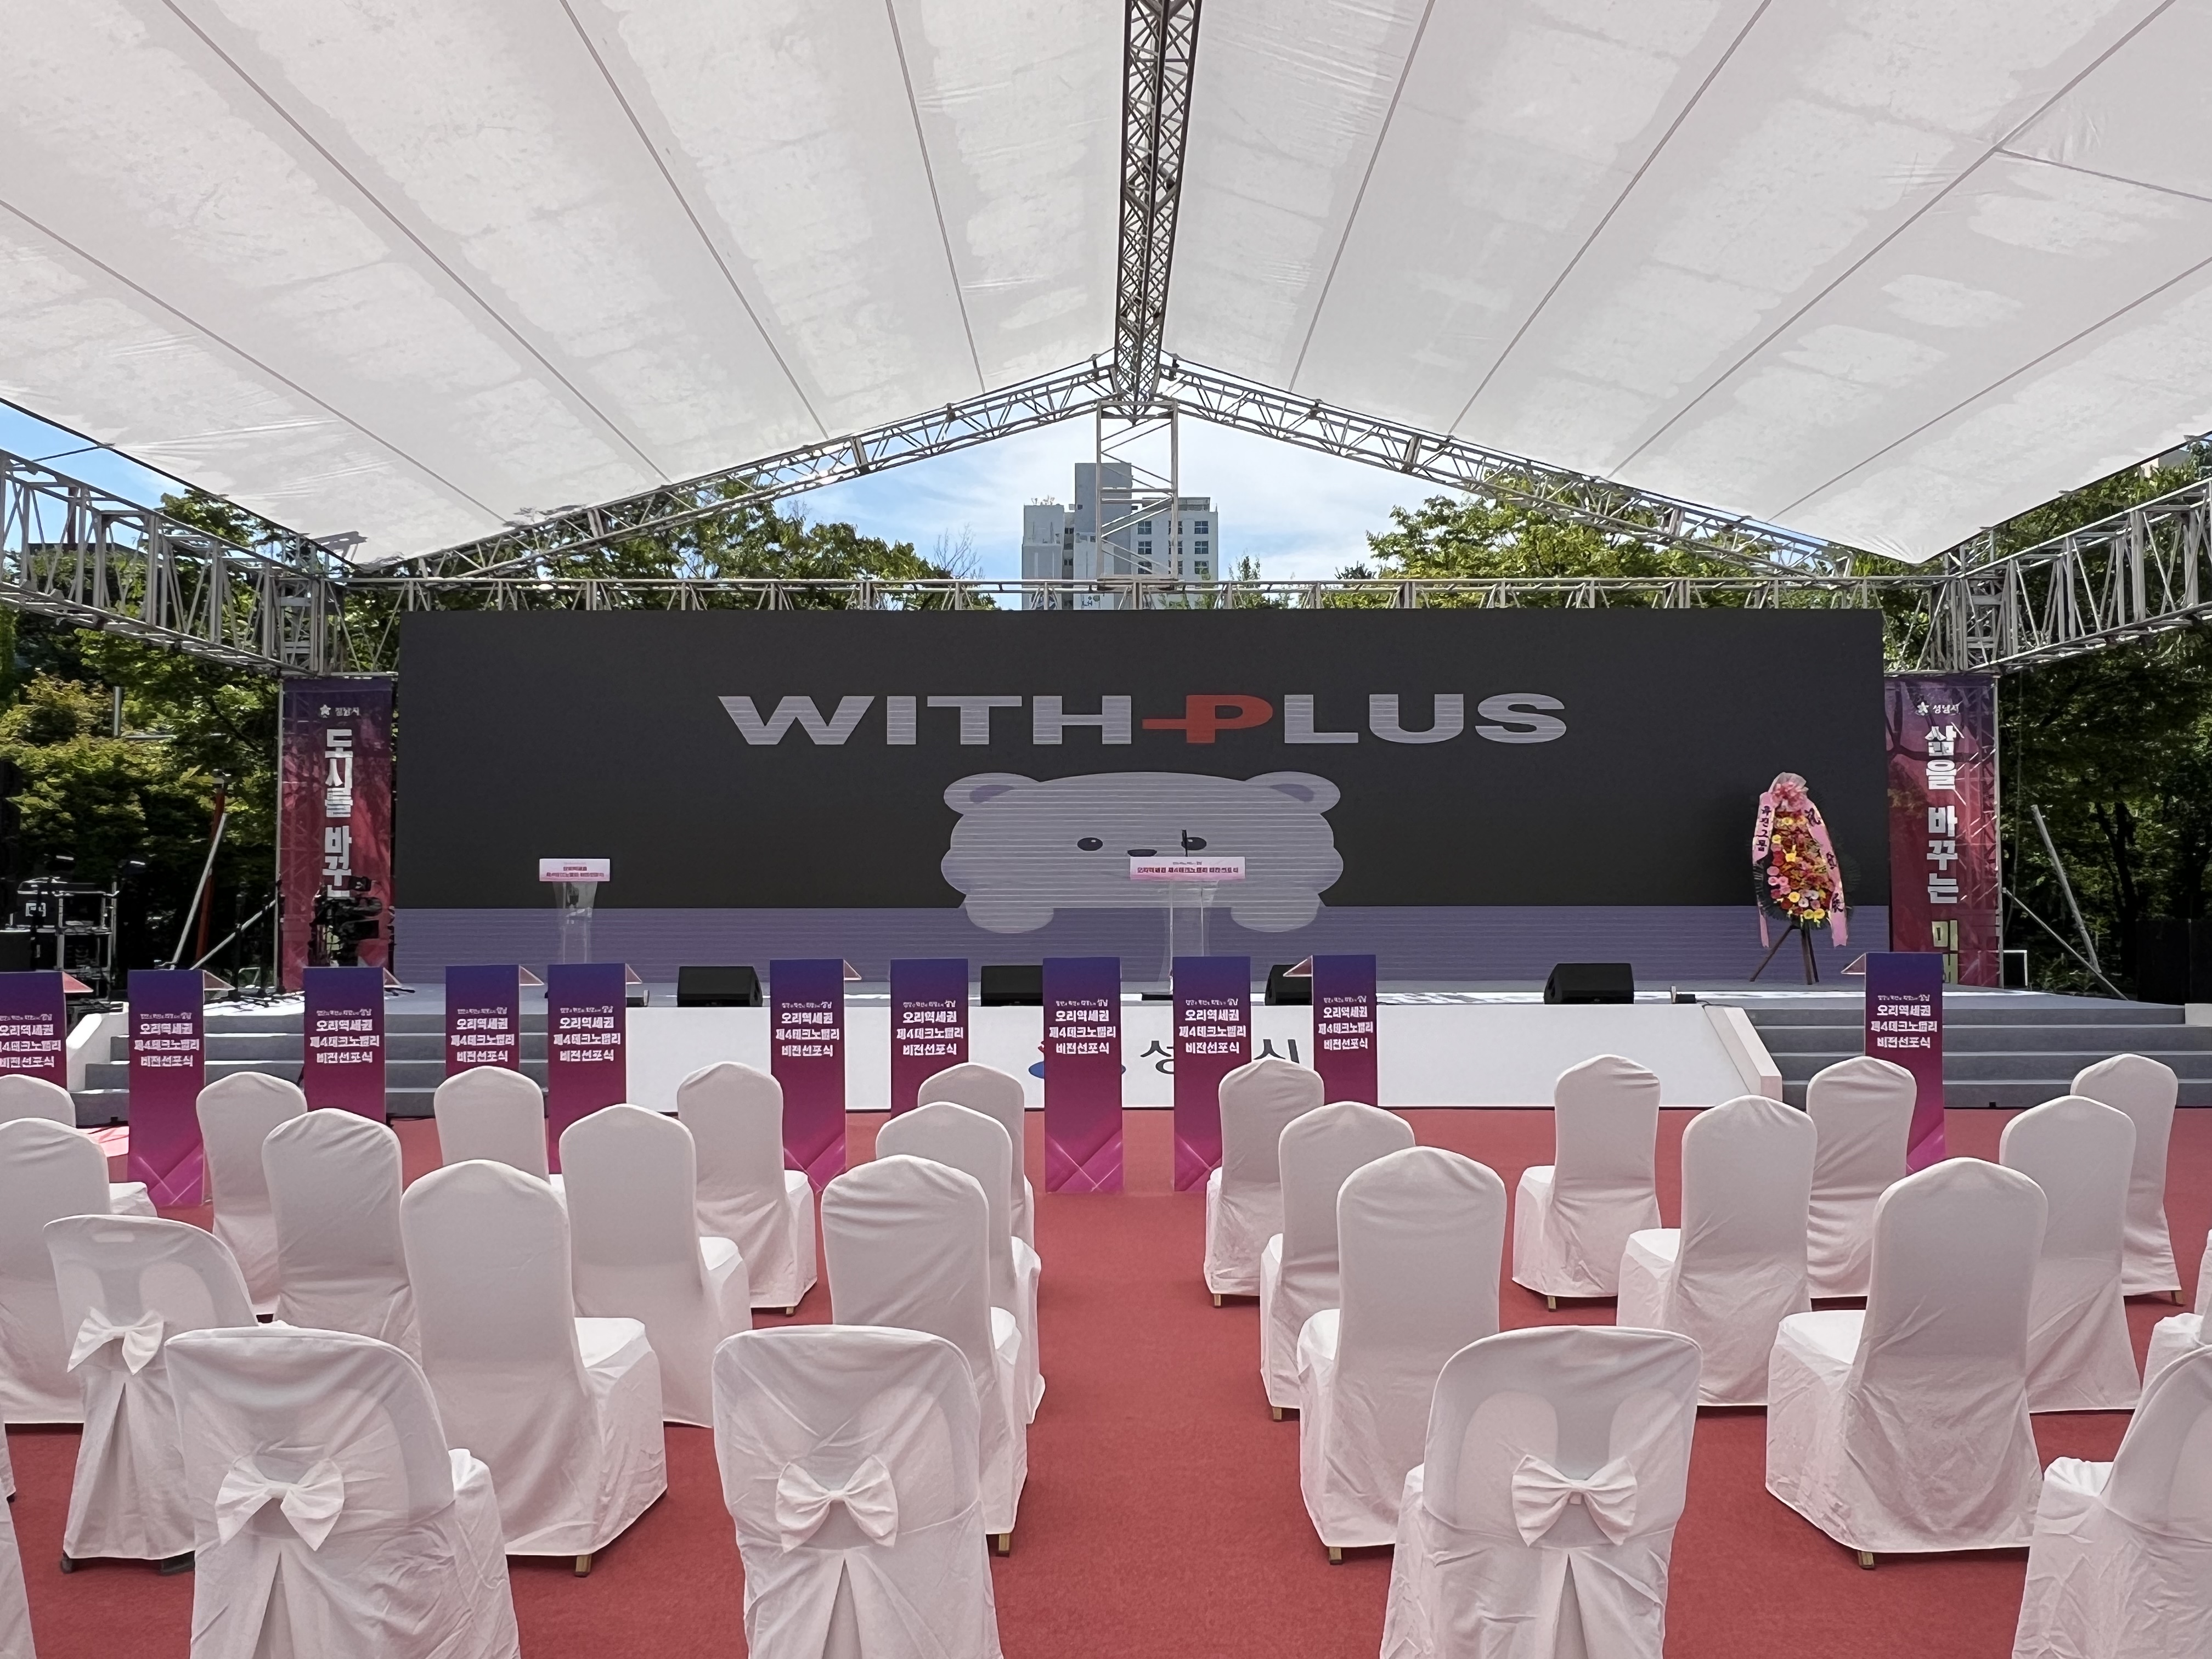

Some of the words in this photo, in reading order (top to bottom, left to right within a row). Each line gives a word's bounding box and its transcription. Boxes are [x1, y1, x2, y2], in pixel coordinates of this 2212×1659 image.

[718, 694, 1132, 746] WITH
[1932, 704, 1959, 714] 성남시
[324, 729, 353, 817] 도시를
[1925, 726, 1957, 789] 삶을
[1927, 805, 1959, 904] 바꾸는
